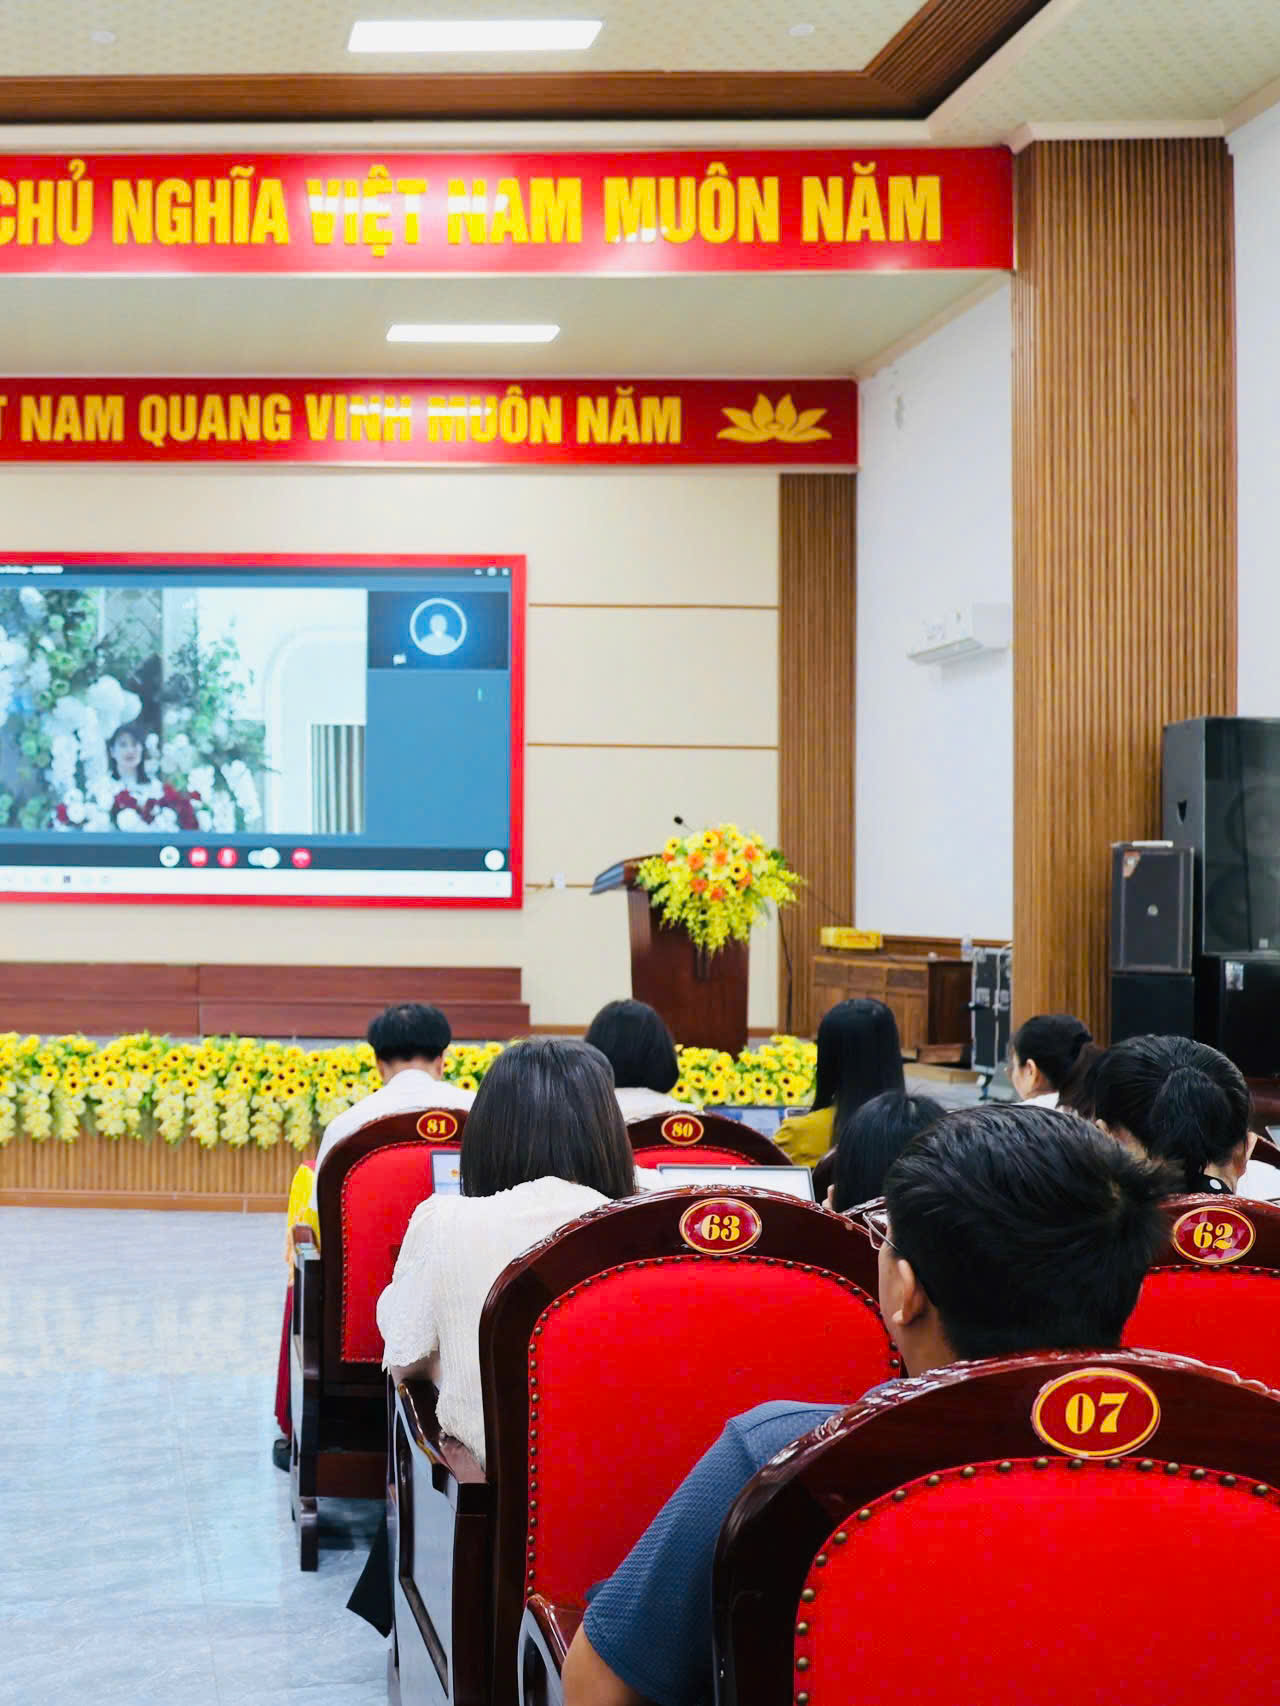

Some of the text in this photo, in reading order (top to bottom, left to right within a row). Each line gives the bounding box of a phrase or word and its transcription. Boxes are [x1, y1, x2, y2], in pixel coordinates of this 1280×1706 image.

[111, 165, 292, 247] NGHĨA
[304, 163, 429, 259] VIỆT
[446, 176, 585, 247] NAM
[603, 162, 780, 245] MUÔN
[802, 162, 942, 243] NĂM
[21, 396, 124, 441] NAM
[139, 394, 292, 448] QUANG
[305, 395, 414, 443] VINH
[426, 386, 563, 445] MUÔN
[576, 386, 681, 444] NĂM
[426, 1118, 446, 1134] 81
[671, 1122, 694, 1139] 80
[701, 1214, 741, 1242] 63
[1192, 1221, 1234, 1250] 62
[1064, 1391, 1130, 1434] 07
